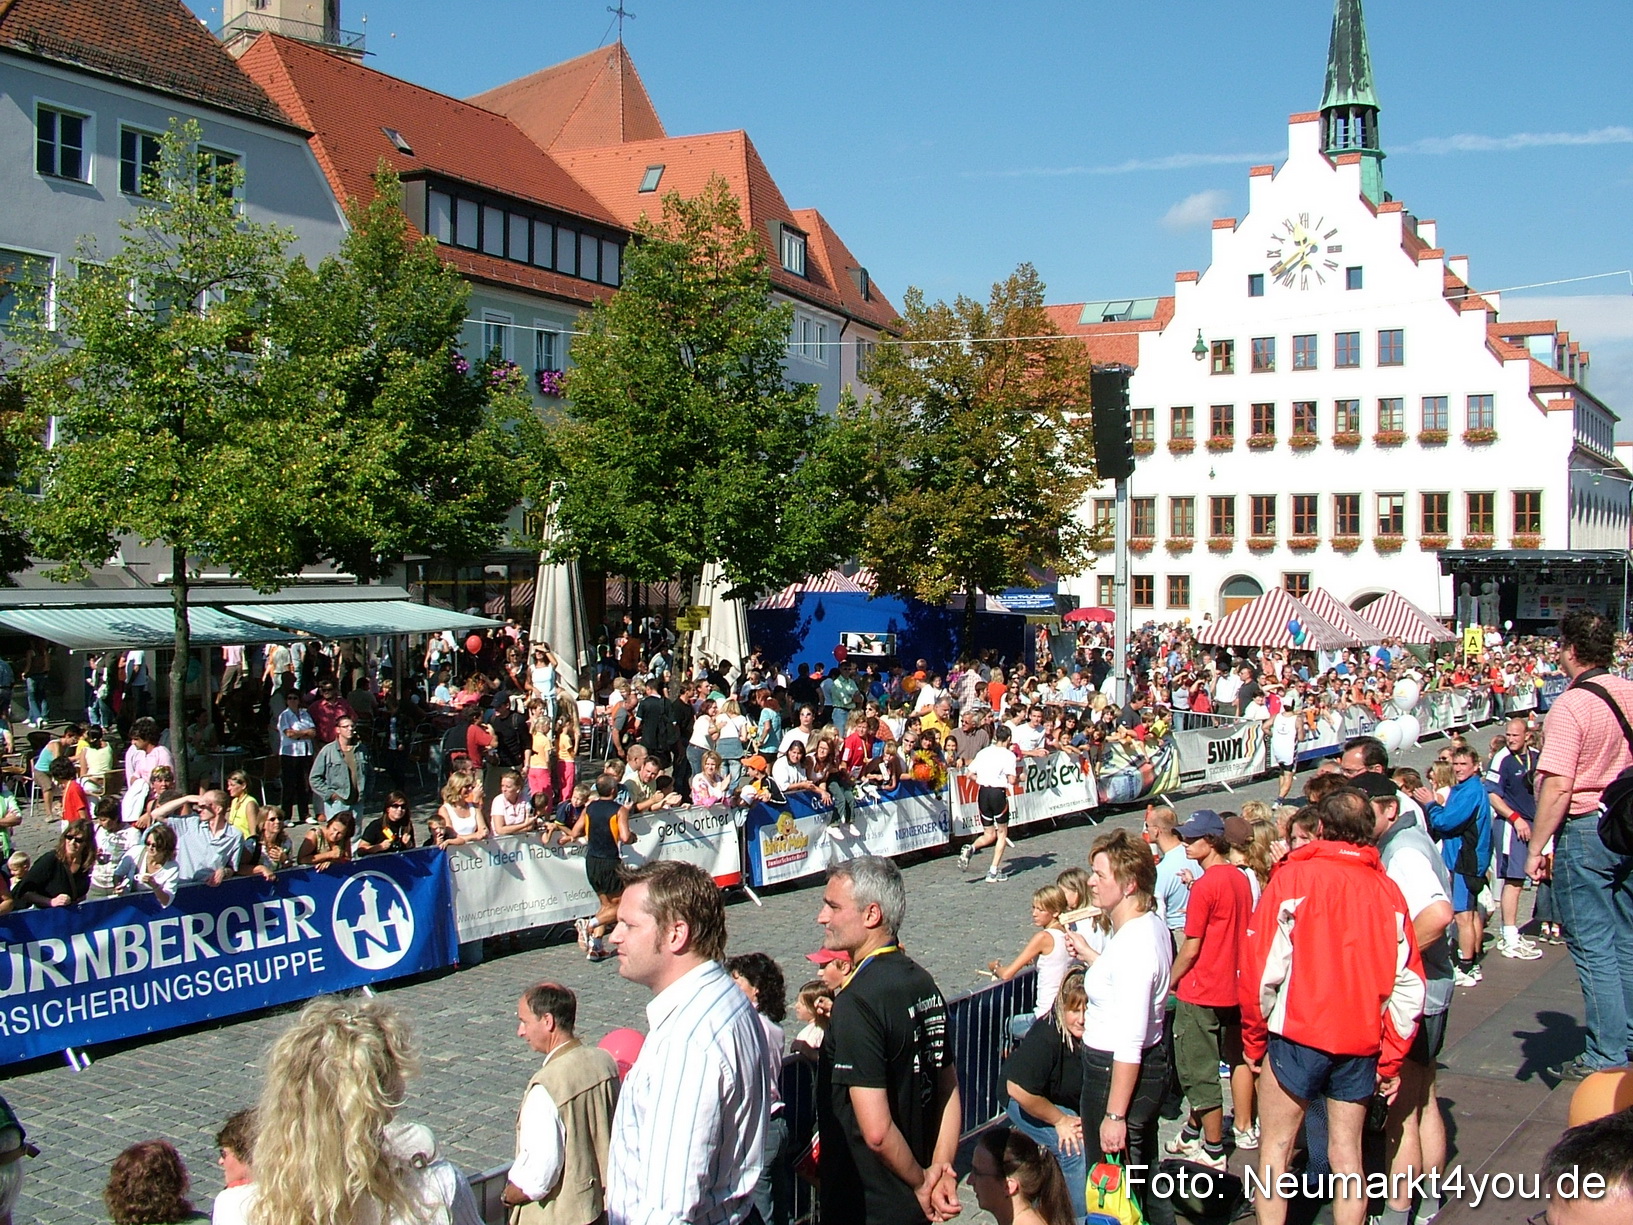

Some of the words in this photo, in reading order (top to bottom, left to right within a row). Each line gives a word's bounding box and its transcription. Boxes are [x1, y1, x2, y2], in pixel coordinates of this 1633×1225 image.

[1468, 636, 1478, 648] A
[1207, 737, 1243, 765] swn
[1025, 760, 1084, 794] Reisen
[658, 816, 687, 842] gerd
[693, 813, 729, 832] ortner
[448, 854, 483, 873] Gute
[488, 849, 524, 867] Ideen
[529, 842, 565, 860] haben
